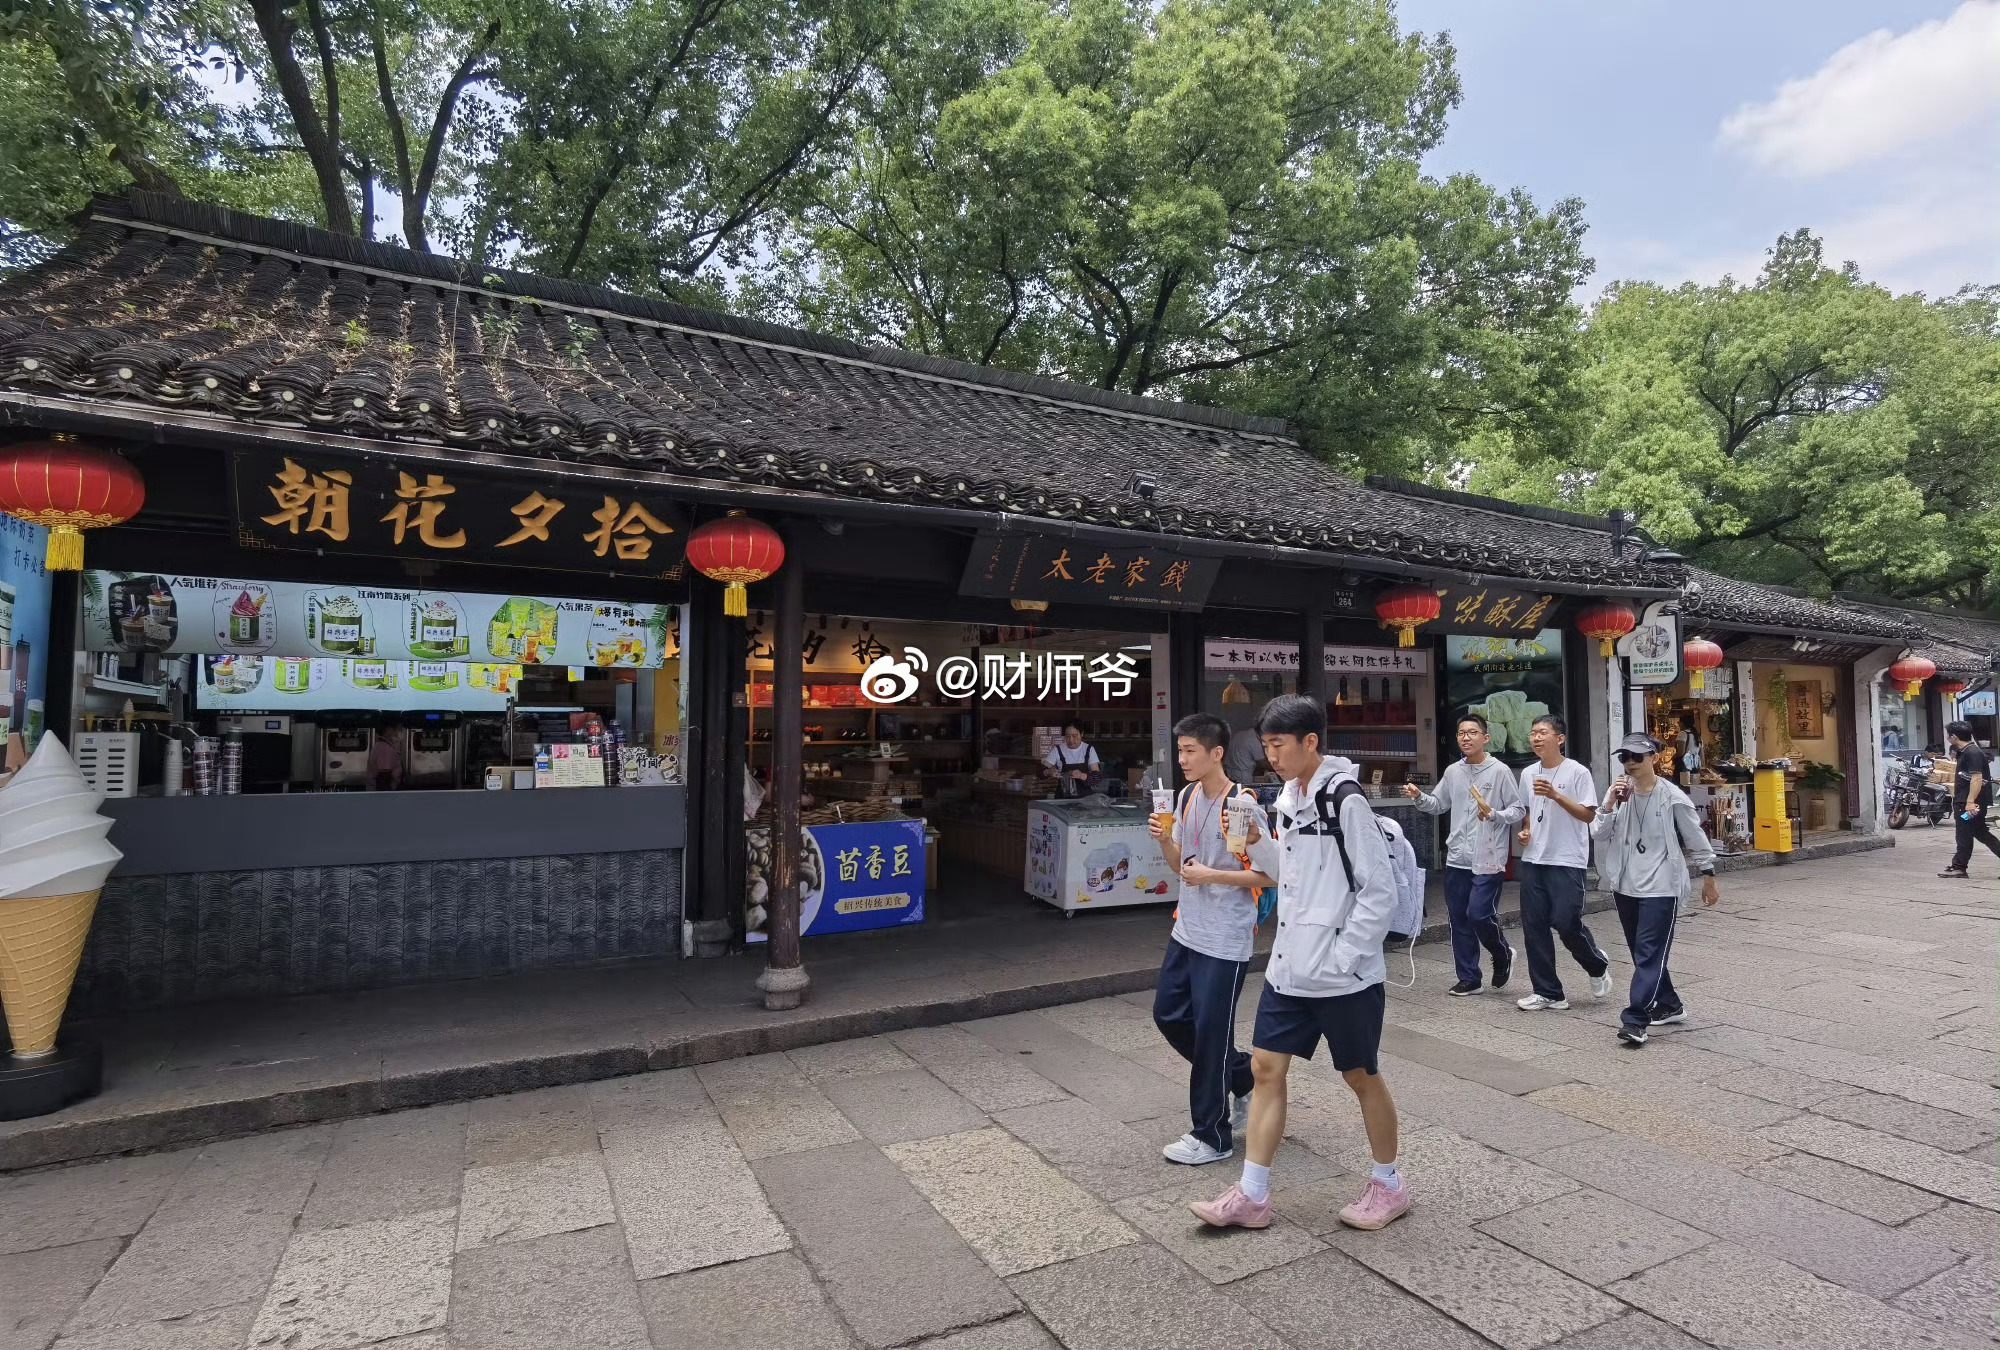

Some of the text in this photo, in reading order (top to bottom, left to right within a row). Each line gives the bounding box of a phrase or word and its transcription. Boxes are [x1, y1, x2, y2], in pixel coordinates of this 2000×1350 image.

[260, 457, 674, 560] 朝花夕拾
[1437, 588, 1552, 629] 味酥屋
[835, 845, 912, 882] 茴香豆
